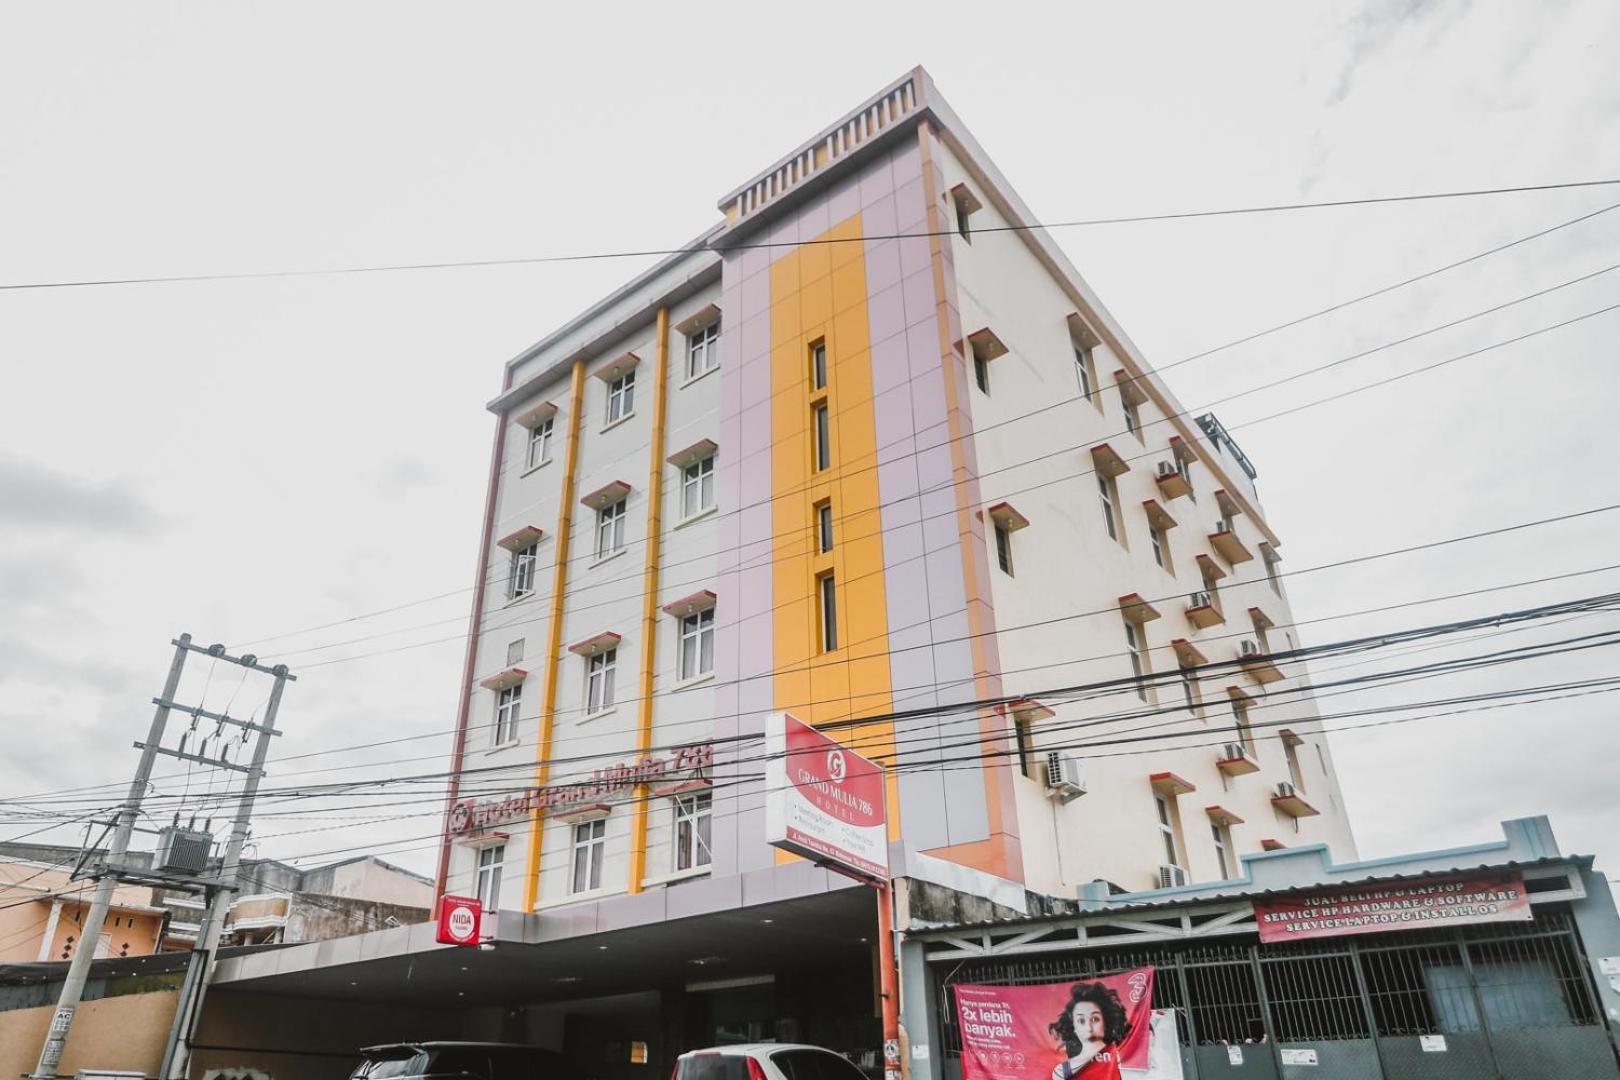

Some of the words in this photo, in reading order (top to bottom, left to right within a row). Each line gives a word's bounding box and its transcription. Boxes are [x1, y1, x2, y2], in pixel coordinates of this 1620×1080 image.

[798, 768, 829, 794] GRAND
[830, 785, 858, 810] MULIA
[859, 799, 873, 816] 786
[816, 796, 854, 822] HOTEL
[1263, 907, 1319, 923] SERVICE
[1321, 906, 1339, 917] HP
[1342, 898, 1421, 914] HARDWARE
[1423, 896, 1434, 907] &
[1437, 890, 1517, 906] SOFTWARE
[1304, 897, 1337, 906] JUAL
[1409, 882, 1464, 896] LAPTOP
[452, 913, 472, 926] NIDA
[1285, 919, 1342, 933] SERVICE
[1345, 913, 1399, 925] LAPTOP
[1401, 911, 1411, 921] &
[1415, 905, 1476, 920] INSTALL
[1478, 903, 1497, 914] OS
[962, 1006, 977, 1021] 2x
[980, 1008, 1013, 1024] lebih
[965, 1021, 1016, 1038] banyak.
